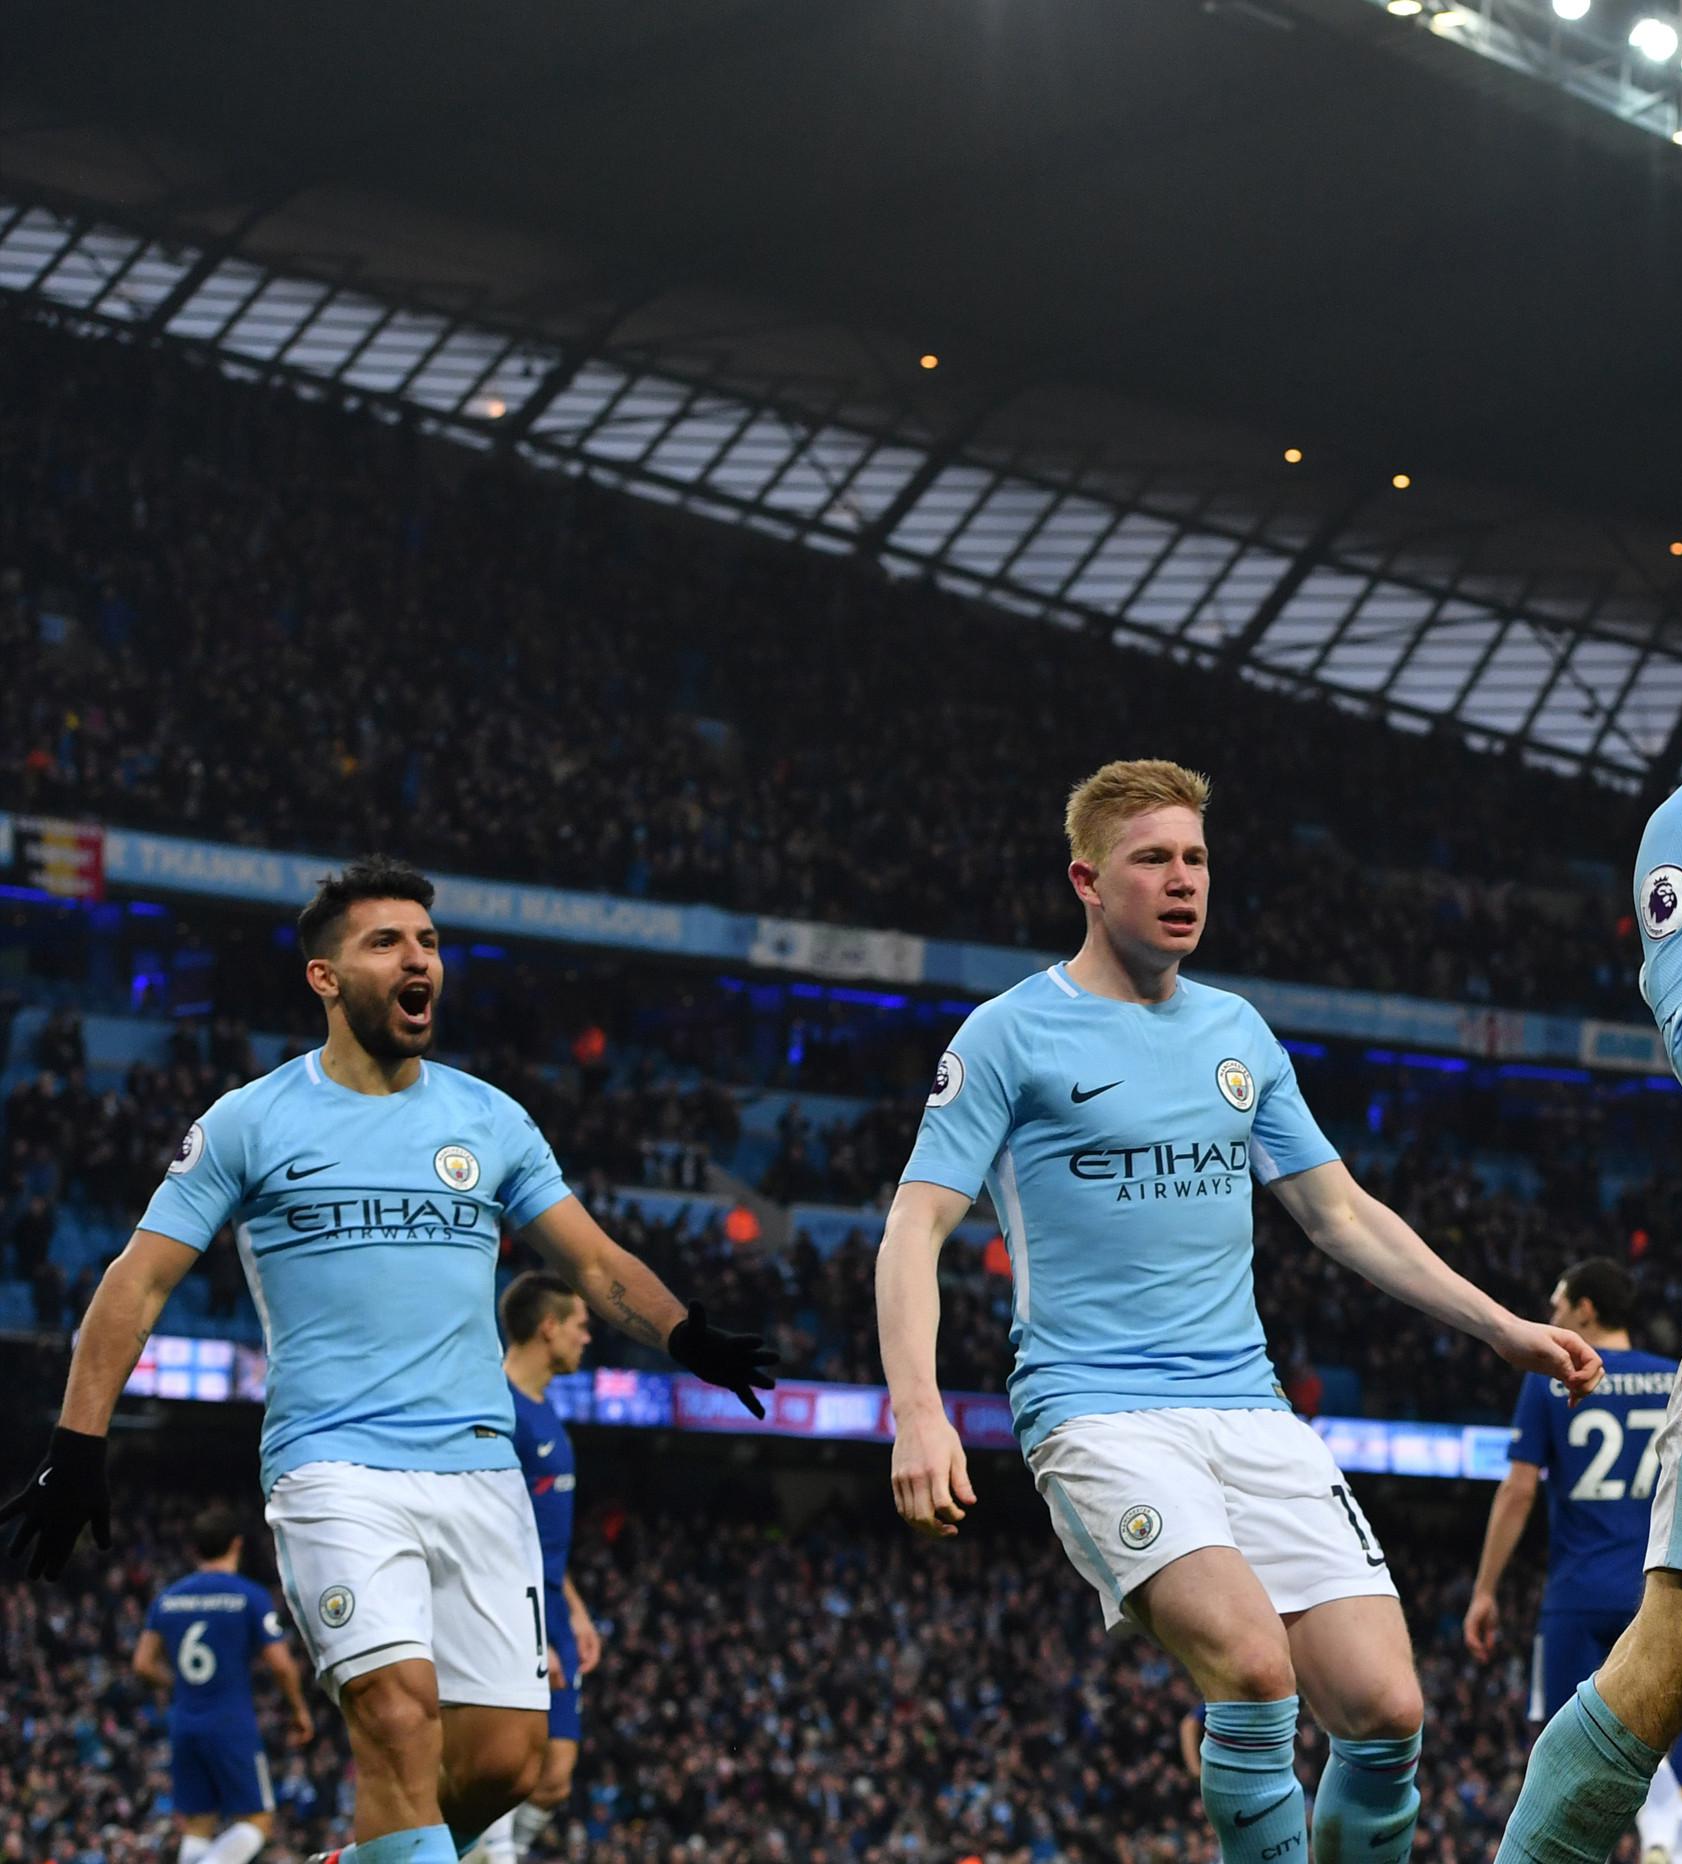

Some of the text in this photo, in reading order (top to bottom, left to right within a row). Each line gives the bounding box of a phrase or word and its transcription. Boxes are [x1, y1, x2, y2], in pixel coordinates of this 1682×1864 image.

[1069, 1141, 1248, 1180] ETIHAD
[1116, 1177, 1233, 1203] AIRWAYS
[286, 1199, 481, 1232] ETIHAD
[1567, 1407, 1669, 1501] 27
[178, 1620, 217, 1686] 6
[1261, 1831, 1301, 1862] CITY
